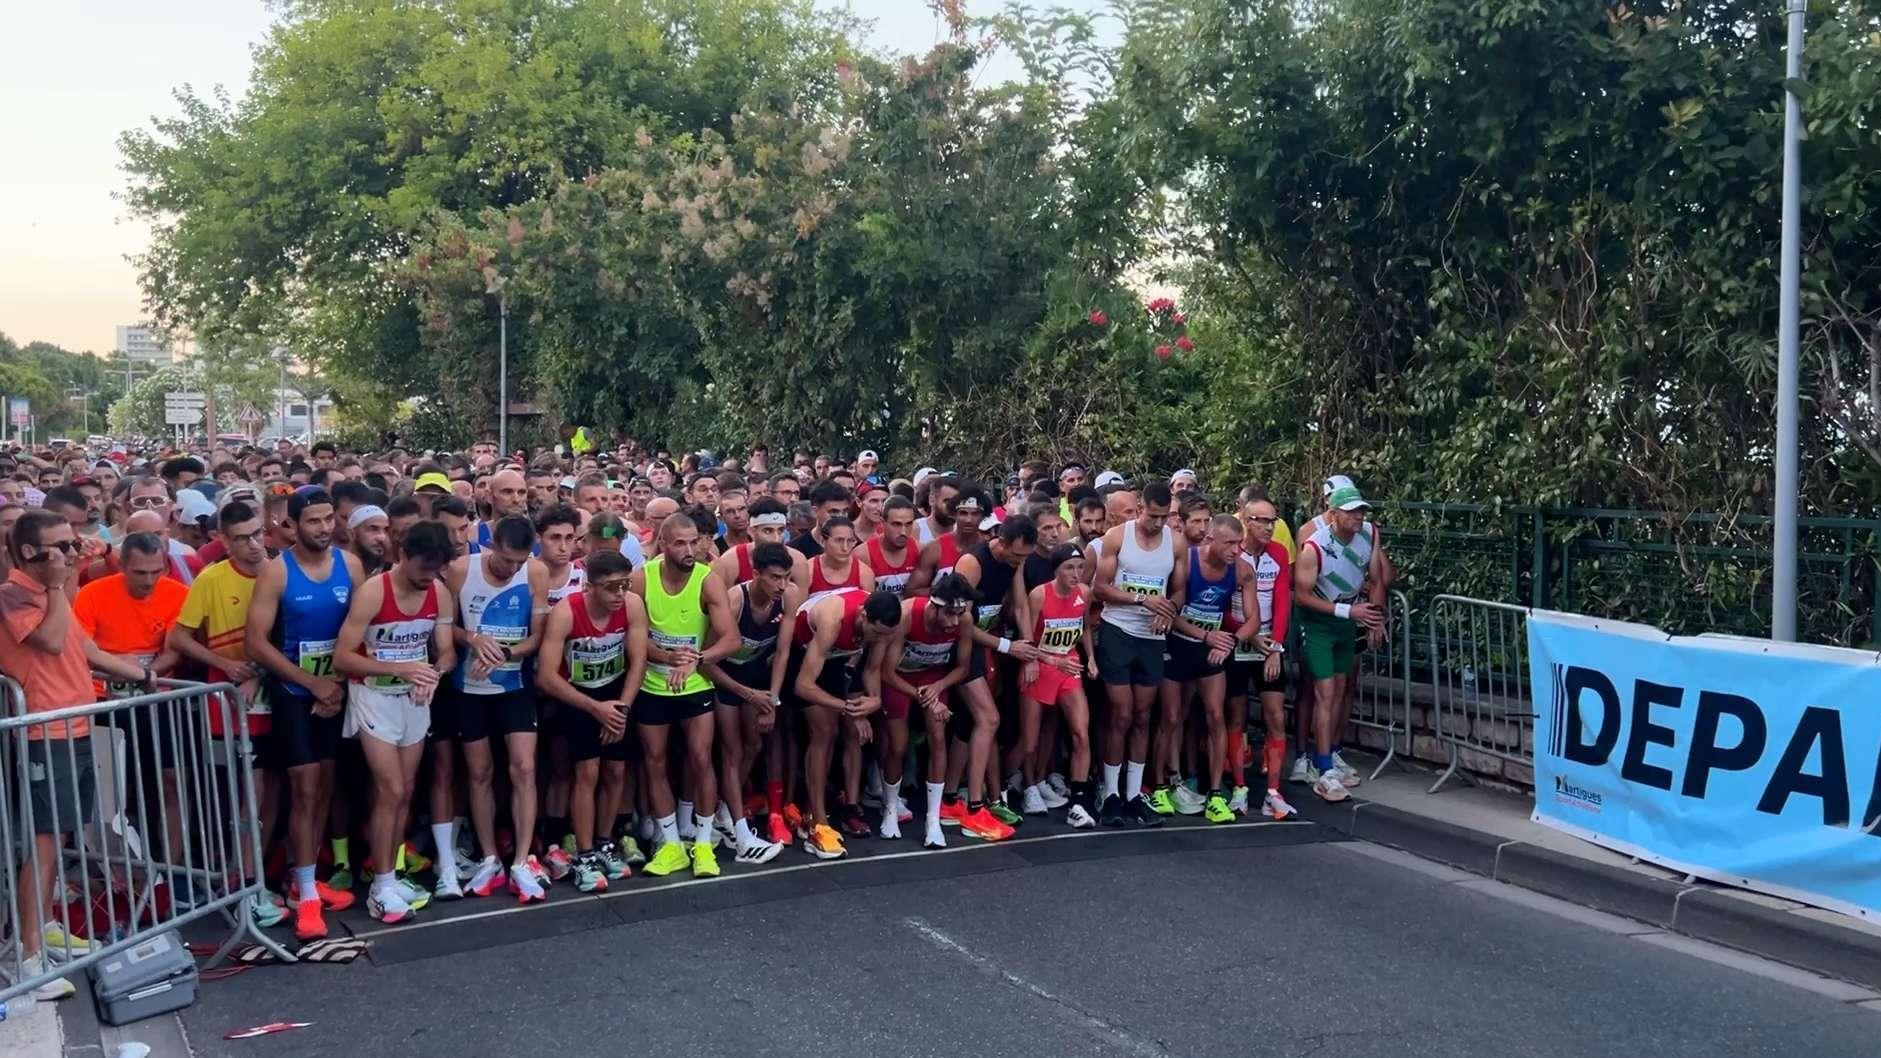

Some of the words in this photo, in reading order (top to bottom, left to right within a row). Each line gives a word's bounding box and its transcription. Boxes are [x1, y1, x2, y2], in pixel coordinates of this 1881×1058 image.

[1045, 628, 1081, 647] 1002
[583, 659, 616, 681] 574
[1563, 664, 1881, 838] DEPA
